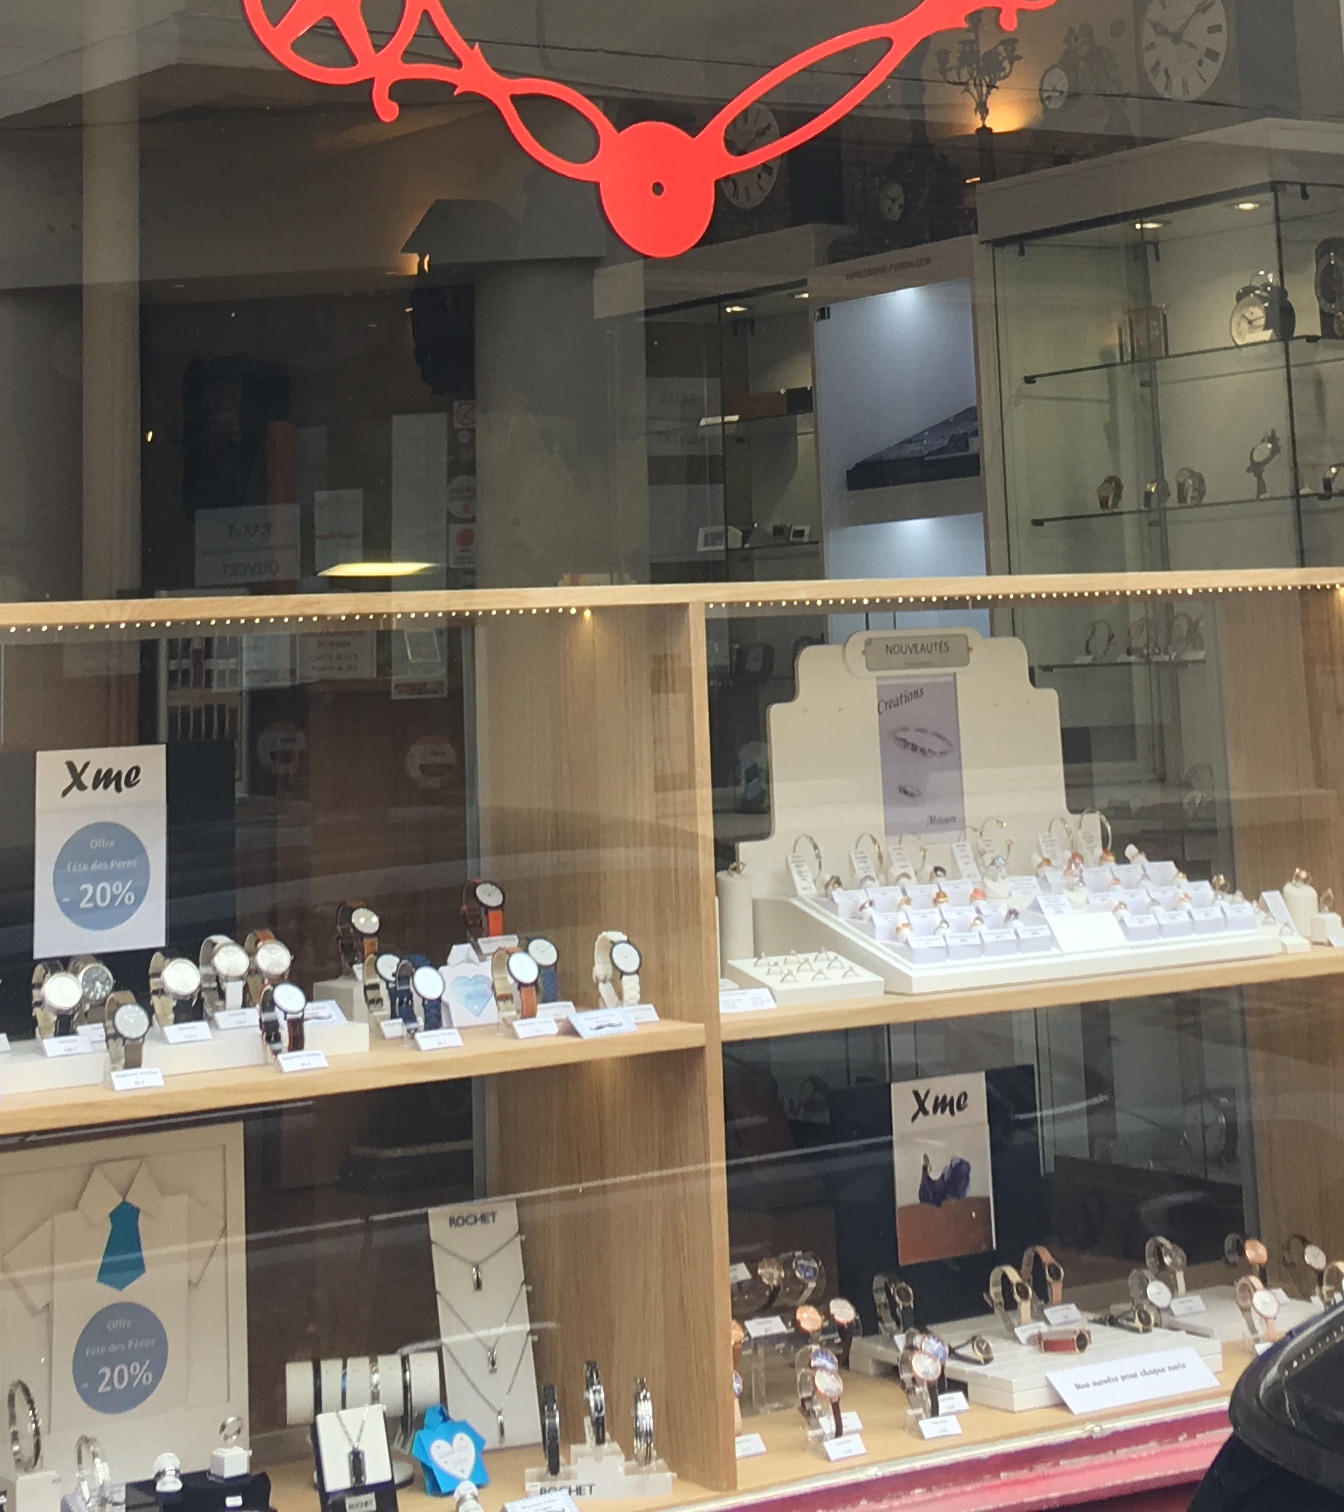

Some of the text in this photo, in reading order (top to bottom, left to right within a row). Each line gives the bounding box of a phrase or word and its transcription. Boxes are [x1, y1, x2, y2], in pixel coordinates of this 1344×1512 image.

[885, 640, 950, 655] NOUVEAUTÉS
[79, 880, 136, 909] 20%
[449, 1211, 498, 1229] ROCHET
[97, 1359, 153, 1393] 20%
